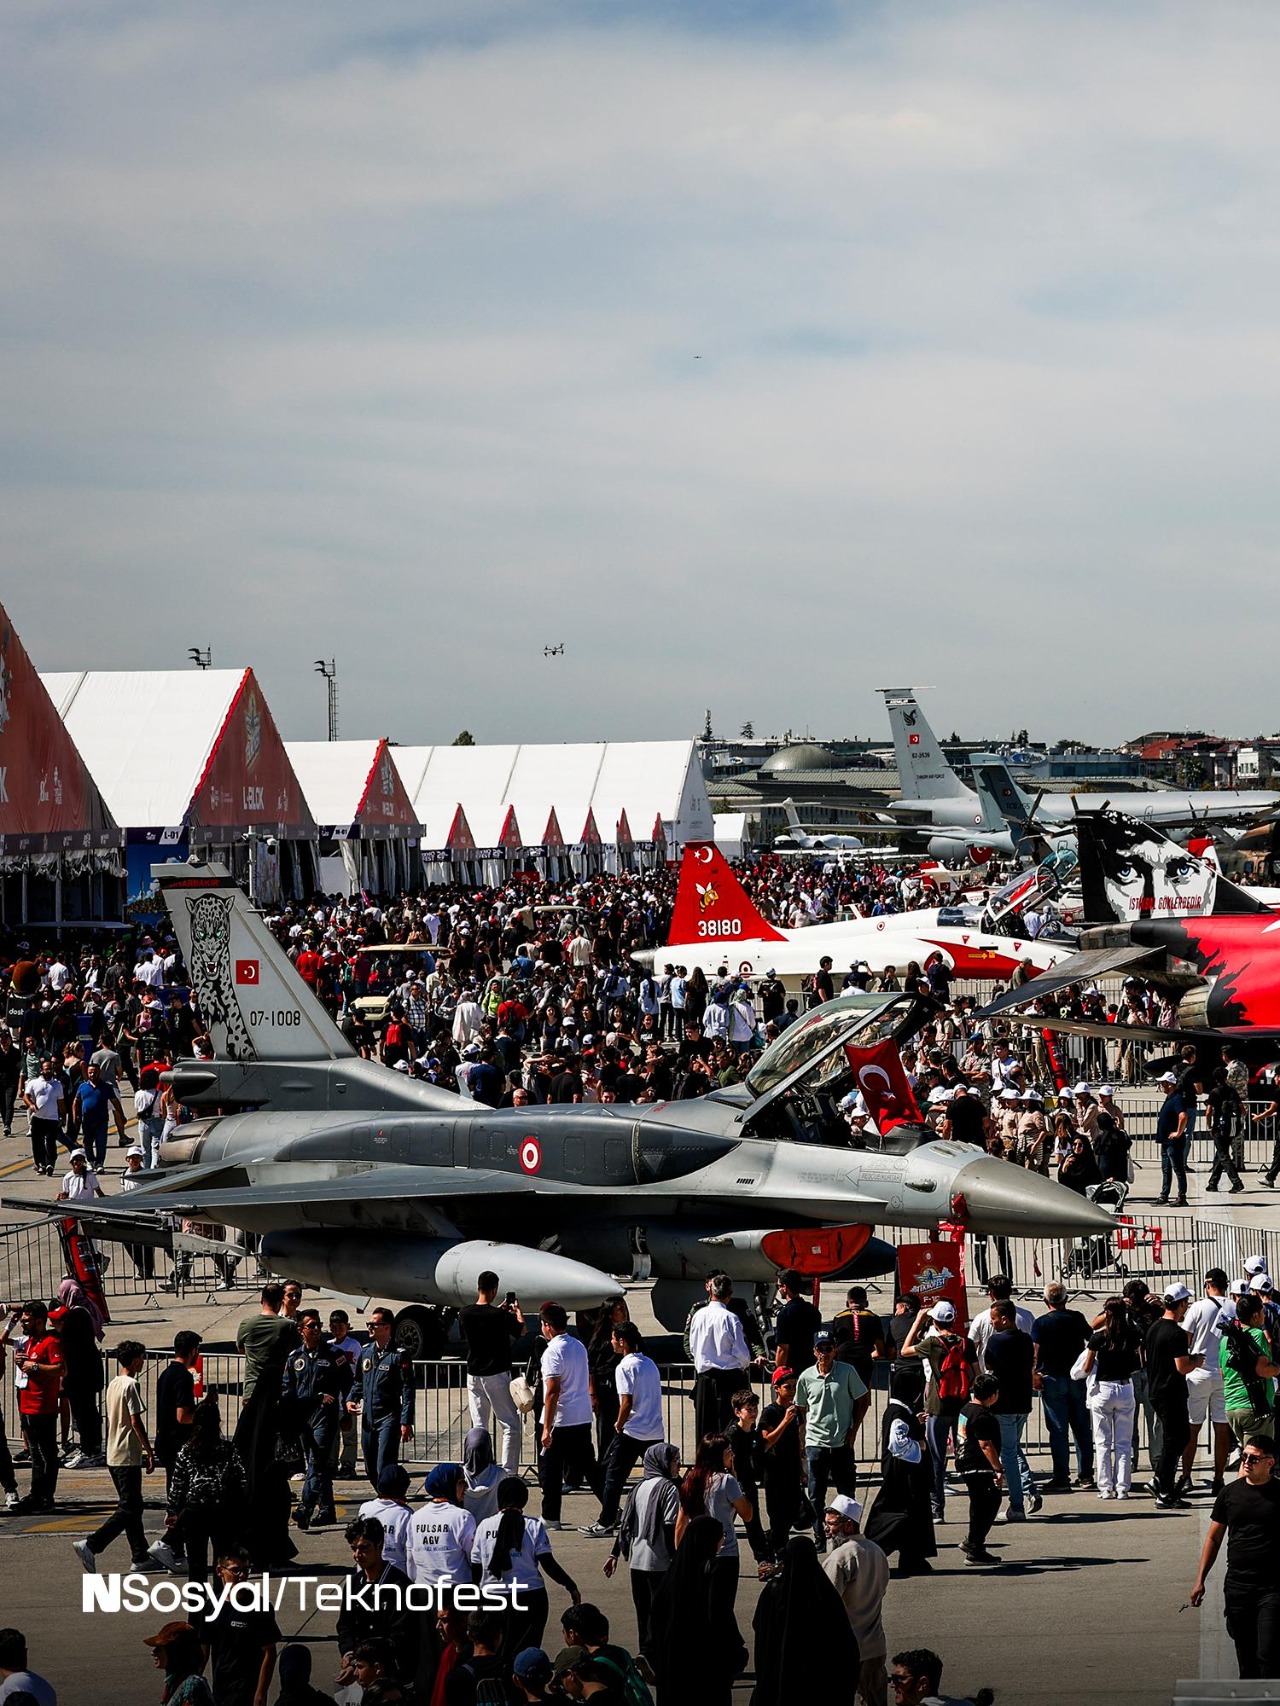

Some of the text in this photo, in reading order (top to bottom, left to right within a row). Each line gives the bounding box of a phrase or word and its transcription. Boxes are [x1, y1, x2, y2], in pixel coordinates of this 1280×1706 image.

[164, 832, 179, 840] L-01
[698, 918, 741, 936] 38180
[250, 1010, 301, 1026] 07-1008
[416, 1523, 449, 1533] PULSAR
[422, 1535, 440, 1545] AGV
